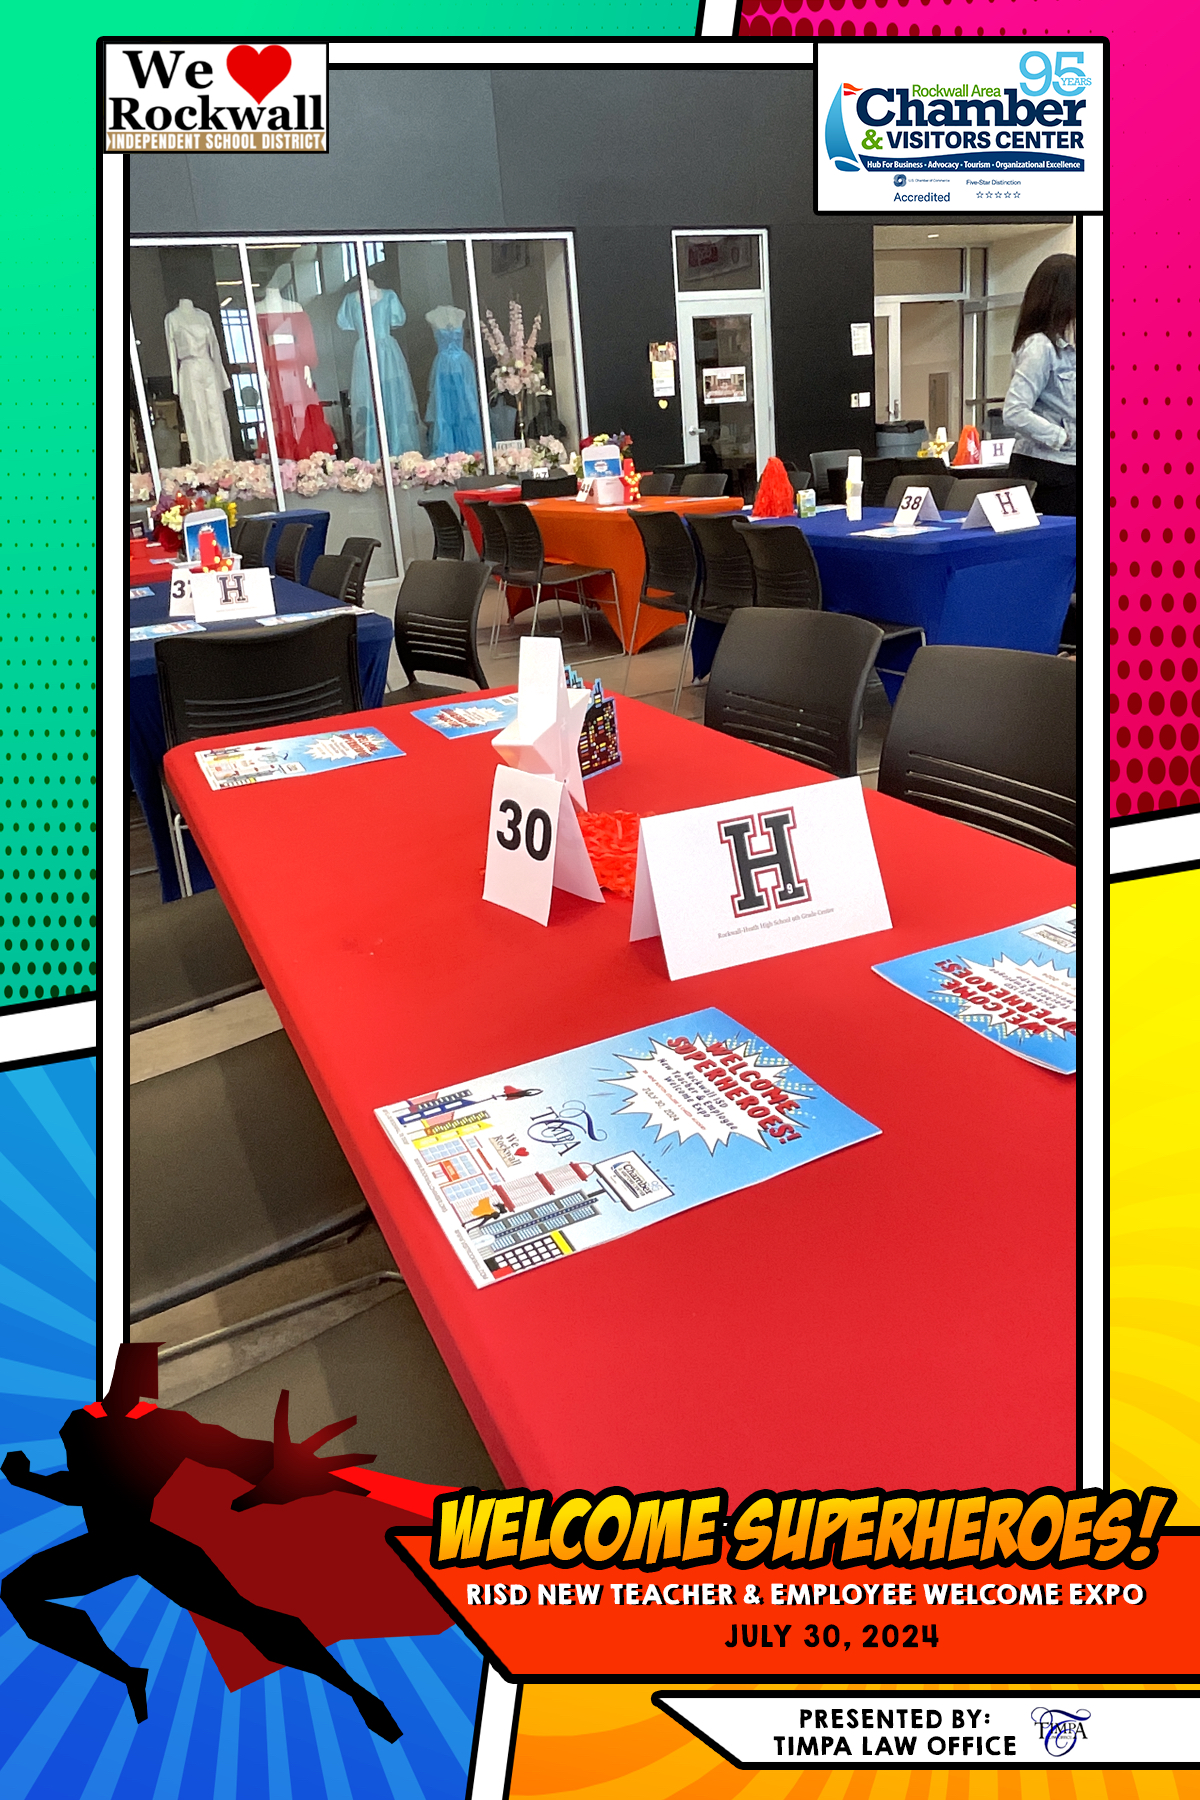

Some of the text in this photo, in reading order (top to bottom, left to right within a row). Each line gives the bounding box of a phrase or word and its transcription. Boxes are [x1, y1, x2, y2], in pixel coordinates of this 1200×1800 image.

[901, 495, 922, 511] 38
[995, 491, 1018, 515] H
[217, 573, 249, 605] H
[496, 798, 552, 862] 30
[718, 806, 811, 918] H
[786, 883, 794, 895] 9
[939, 978, 1050, 1036] WELCOME
[658, 1058, 674, 1071] New
[672, 1070, 699, 1094] Teacher
[703, 1100, 738, 1130] Employee
[664, 1076, 711, 1118] Welcome Expo
[667, 1036, 802, 1145] SUPERHEROES!
[684, 1071, 729, 1108] Rockwall ISD
[706, 1042, 801, 1115] WELCOME
[494, 1135, 522, 1166] Rockwall
[506, 1133, 520, 1149] We
[623, 1164, 653, 1195] Chamber
